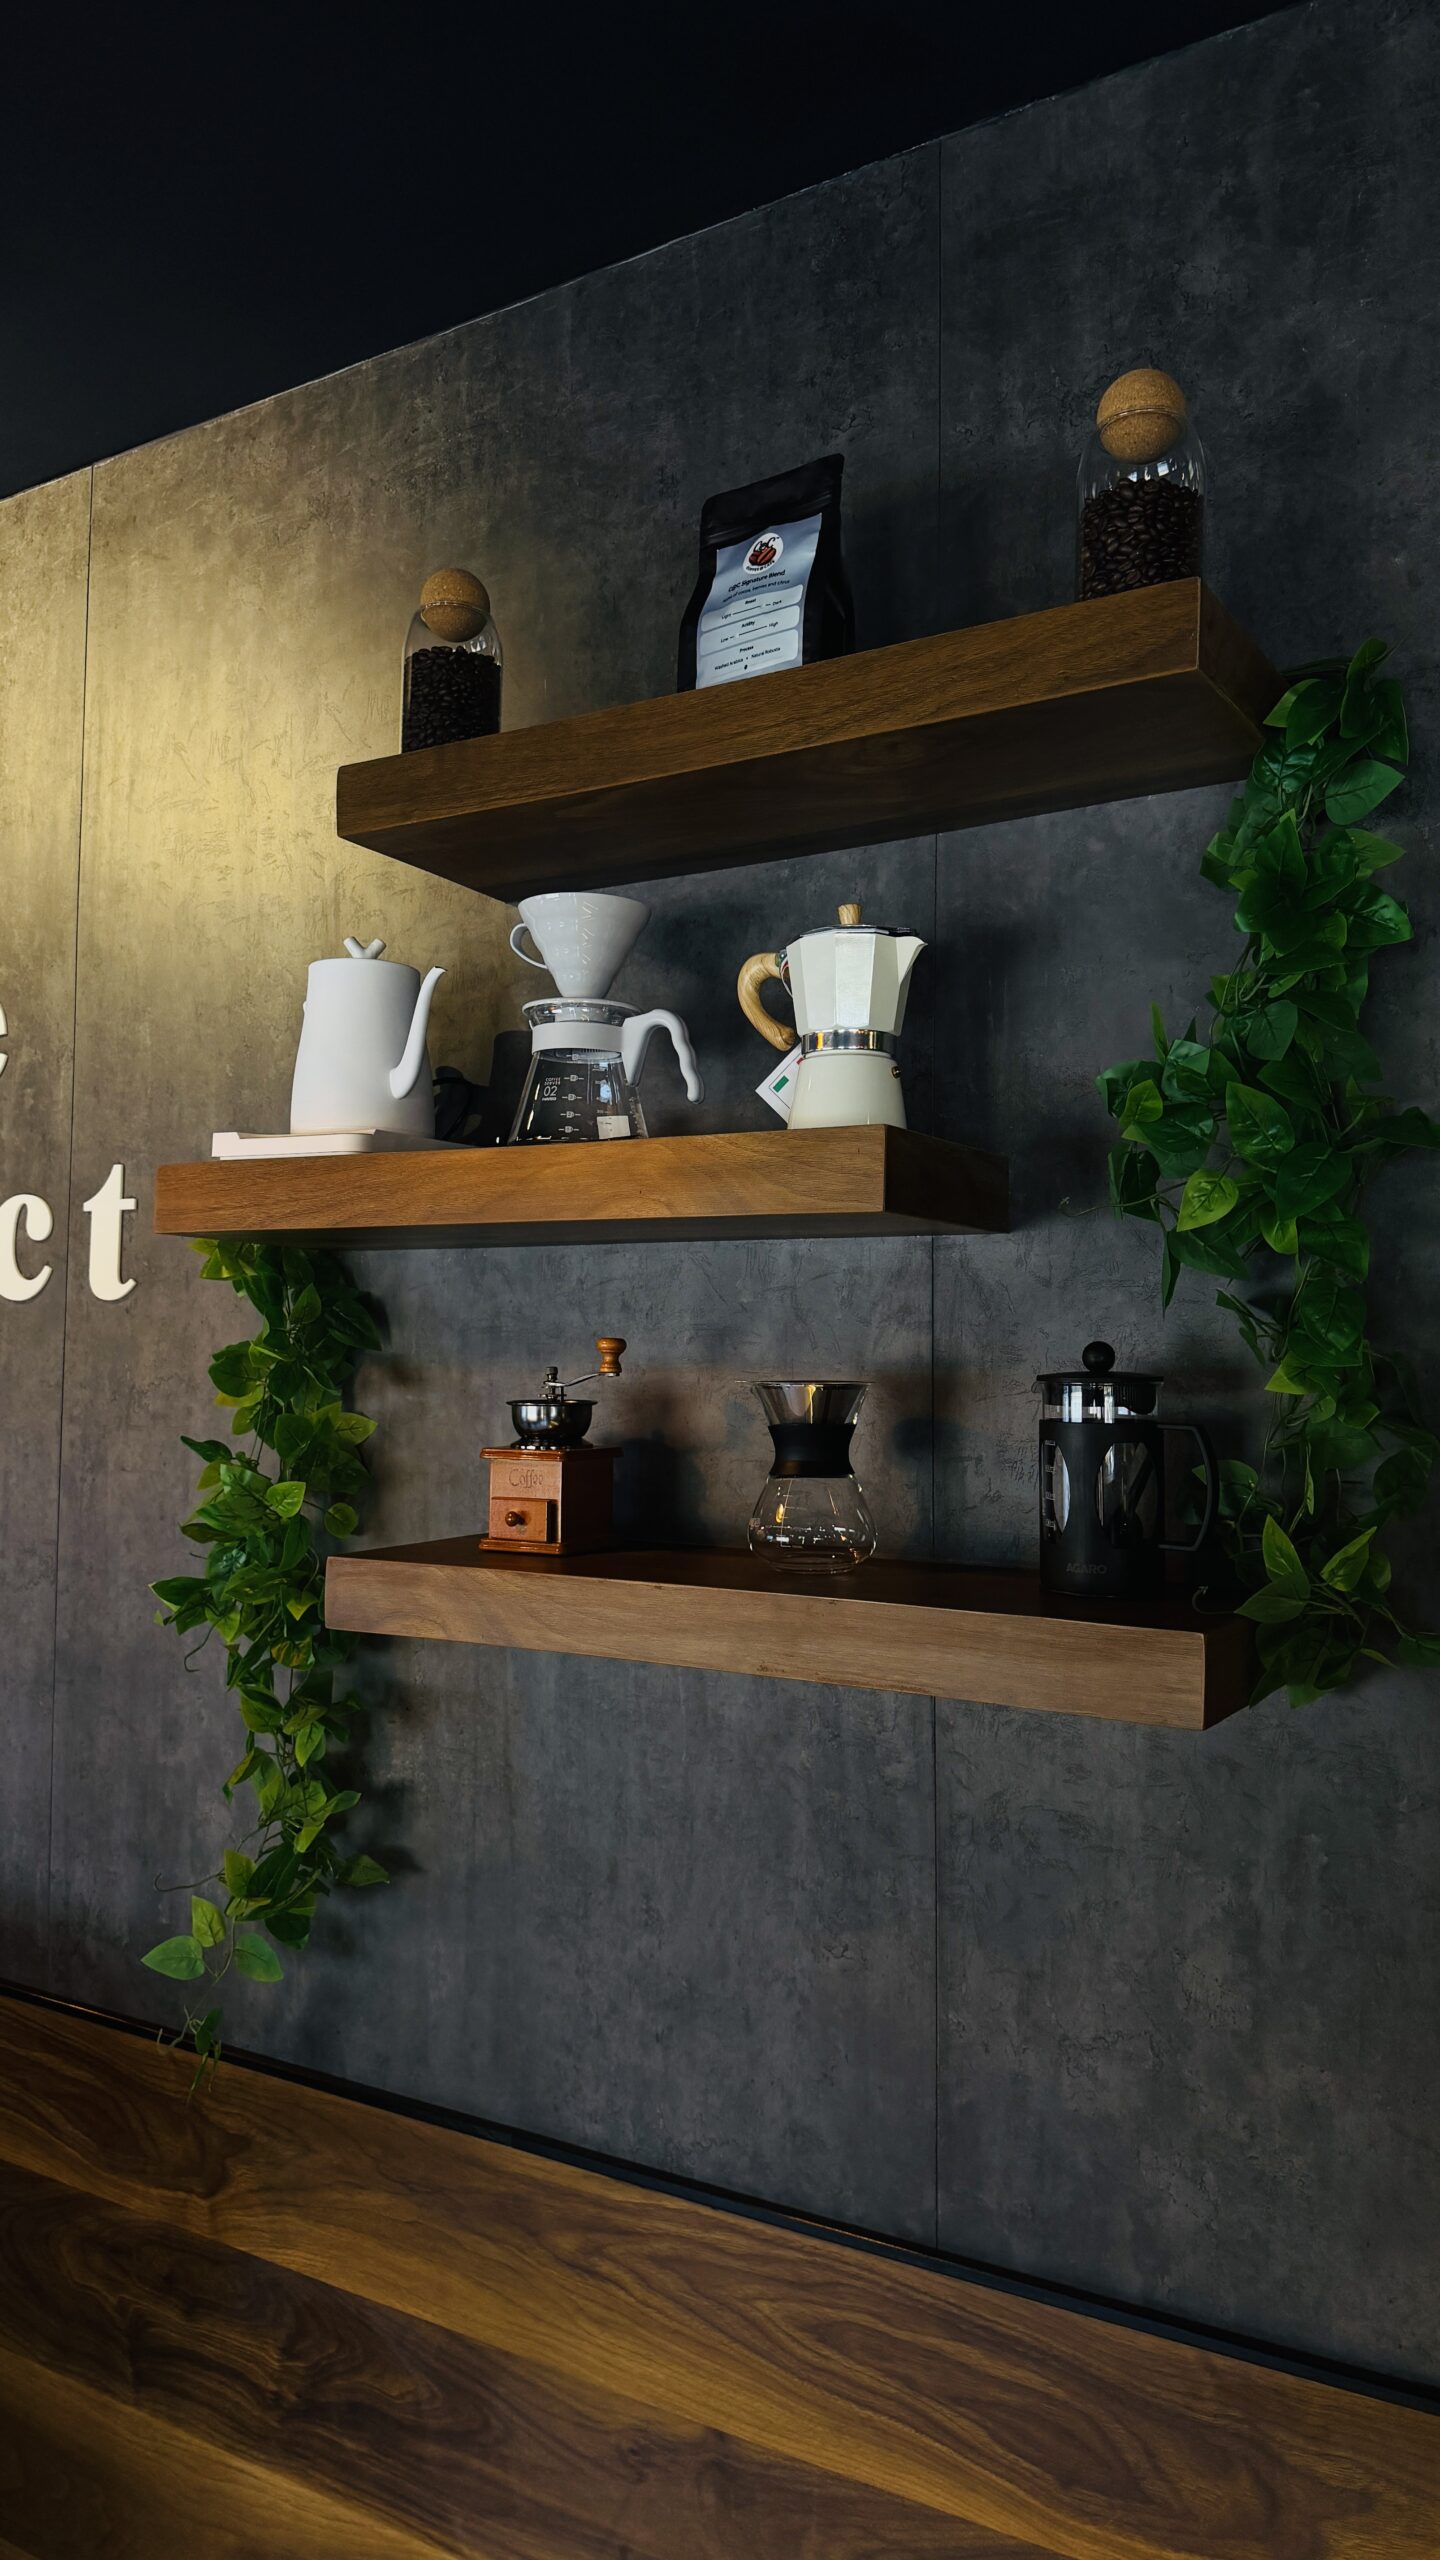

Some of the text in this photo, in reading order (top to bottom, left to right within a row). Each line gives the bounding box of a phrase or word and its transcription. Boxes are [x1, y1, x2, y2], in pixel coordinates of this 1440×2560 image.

[741, 574, 768, 586] Signature
[768, 569, 786, 579] Blend
[744, 597, 756, 605] Roast
[741, 620, 755, 628] Acidity
[720, 636, 729, 644] Low
[739, 645, 754, 653] Process
[729, 657, 744, 667] Arabica
[765, 646, 781, 655] Robusta
[543, 1086, 558, 1097] 02
[508, 1469, 543, 1488] Coffee
[1065, 1562, 1108, 1575] AGARO
